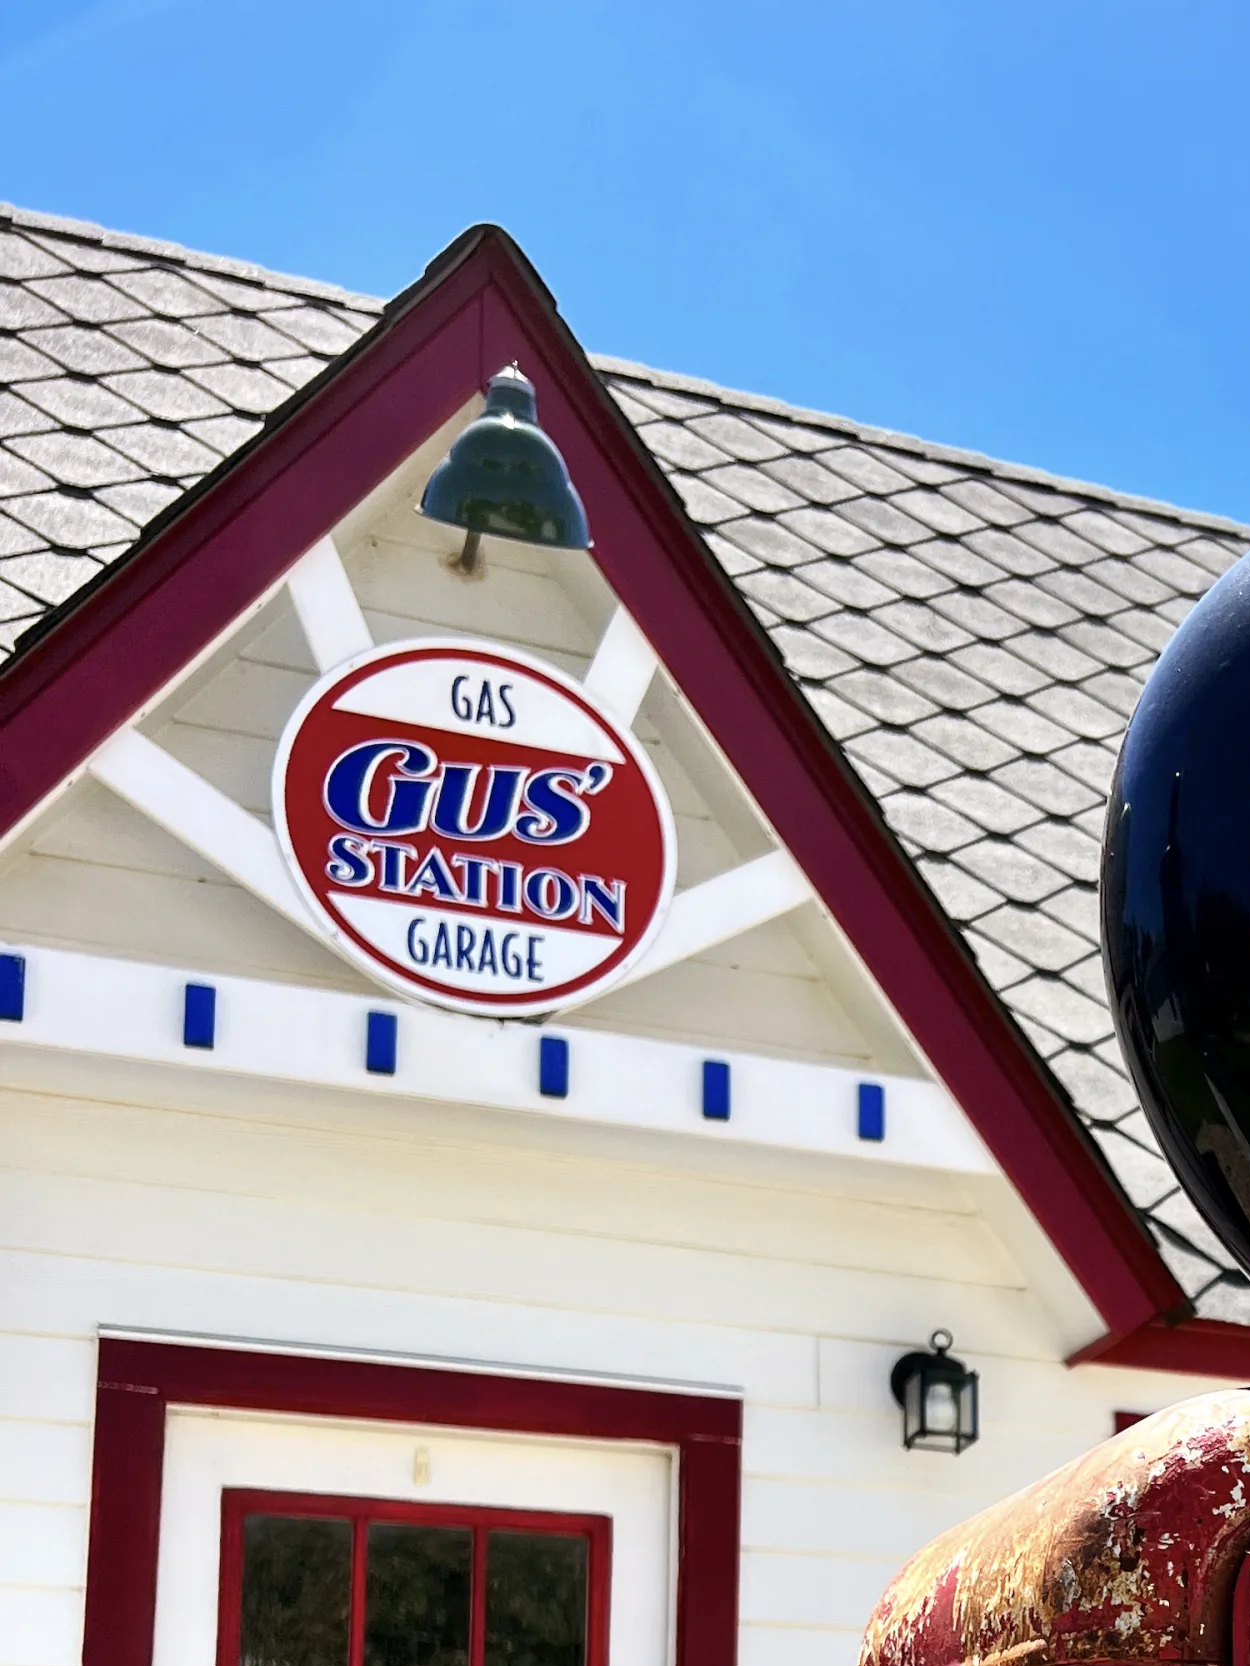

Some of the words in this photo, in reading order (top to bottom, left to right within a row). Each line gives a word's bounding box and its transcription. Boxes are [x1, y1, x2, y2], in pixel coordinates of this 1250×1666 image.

[451, 675, 516, 728] GAS
[325, 832, 627, 934] STATION
[406, 917, 546, 983] GARAGE
